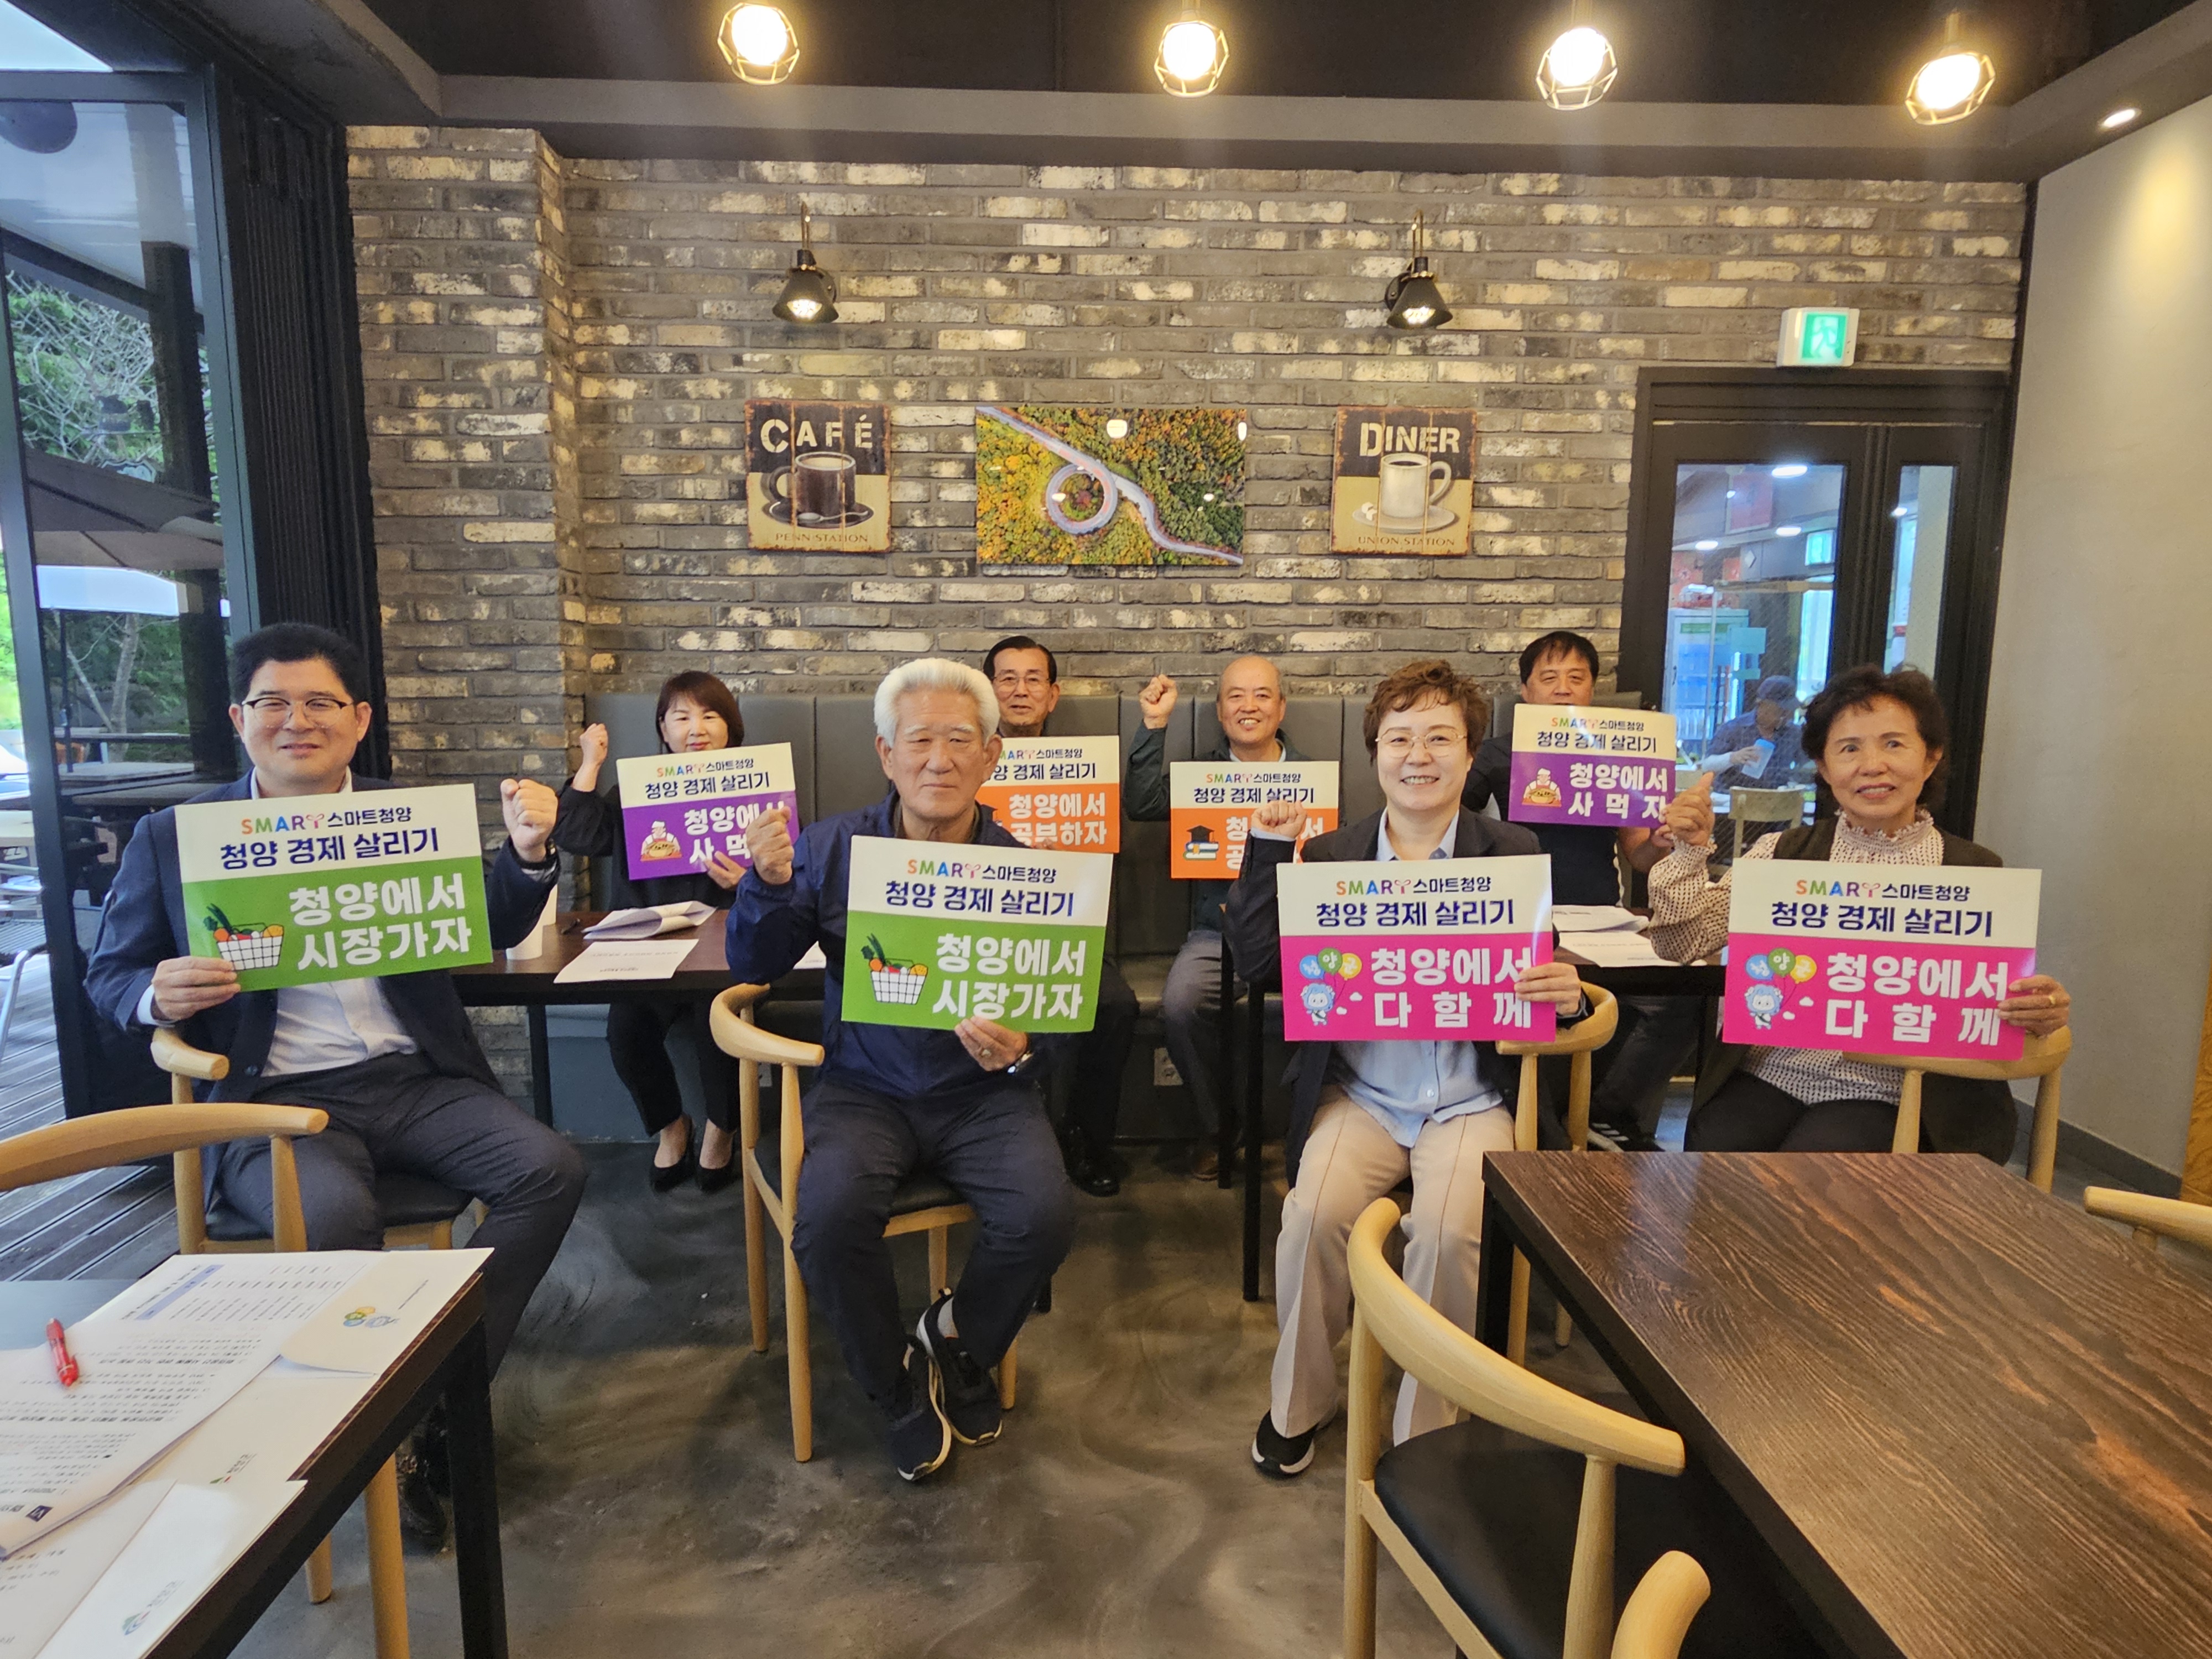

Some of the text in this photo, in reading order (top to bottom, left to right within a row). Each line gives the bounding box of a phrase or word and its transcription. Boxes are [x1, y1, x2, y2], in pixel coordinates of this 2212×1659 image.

[760, 414, 873, 453] CAFÉ
[1359, 422, 1460, 457] DINER
[775, 533, 868, 542] PENN STATION
[1404, 538, 1455, 546] STATION
[1537, 731, 1569, 748] 청양
[1611, 735, 1656, 753] 살리기
[645, 772, 770, 800] 청양 경제 살리기
[987, 763, 1096, 781] 양 경제 살리기
[1569, 763, 1667, 792] 청양에서
[1009, 792, 1105, 819] 청양에서
[1194, 787, 1314, 804] 청양 경제 살리기
[327, 807, 412, 828] 스마트청양
[684, 801, 784, 835] 청양에
[221, 827, 439, 870] 청양 경제 살리기
[982, 864, 1057, 883] 스마트청양
[1413, 877, 1491, 894] 스마트청양
[288, 873, 466, 927] 청양에서
[885, 880, 1074, 917] 청양 경제 살리기
[1882, 883, 1970, 902] 스마트청양
[1316, 899, 1514, 927] 청양 경제 살리기
[1771, 901, 1993, 937] 청양 경제 살리기
[297, 916, 472, 971] 시장가자
[936, 933, 1086, 977] 청양에서
[1371, 947, 1533, 986] 청양에서
[1826, 952, 2009, 1001] 청양에서
[932, 979, 1083, 1020] 시장가자
